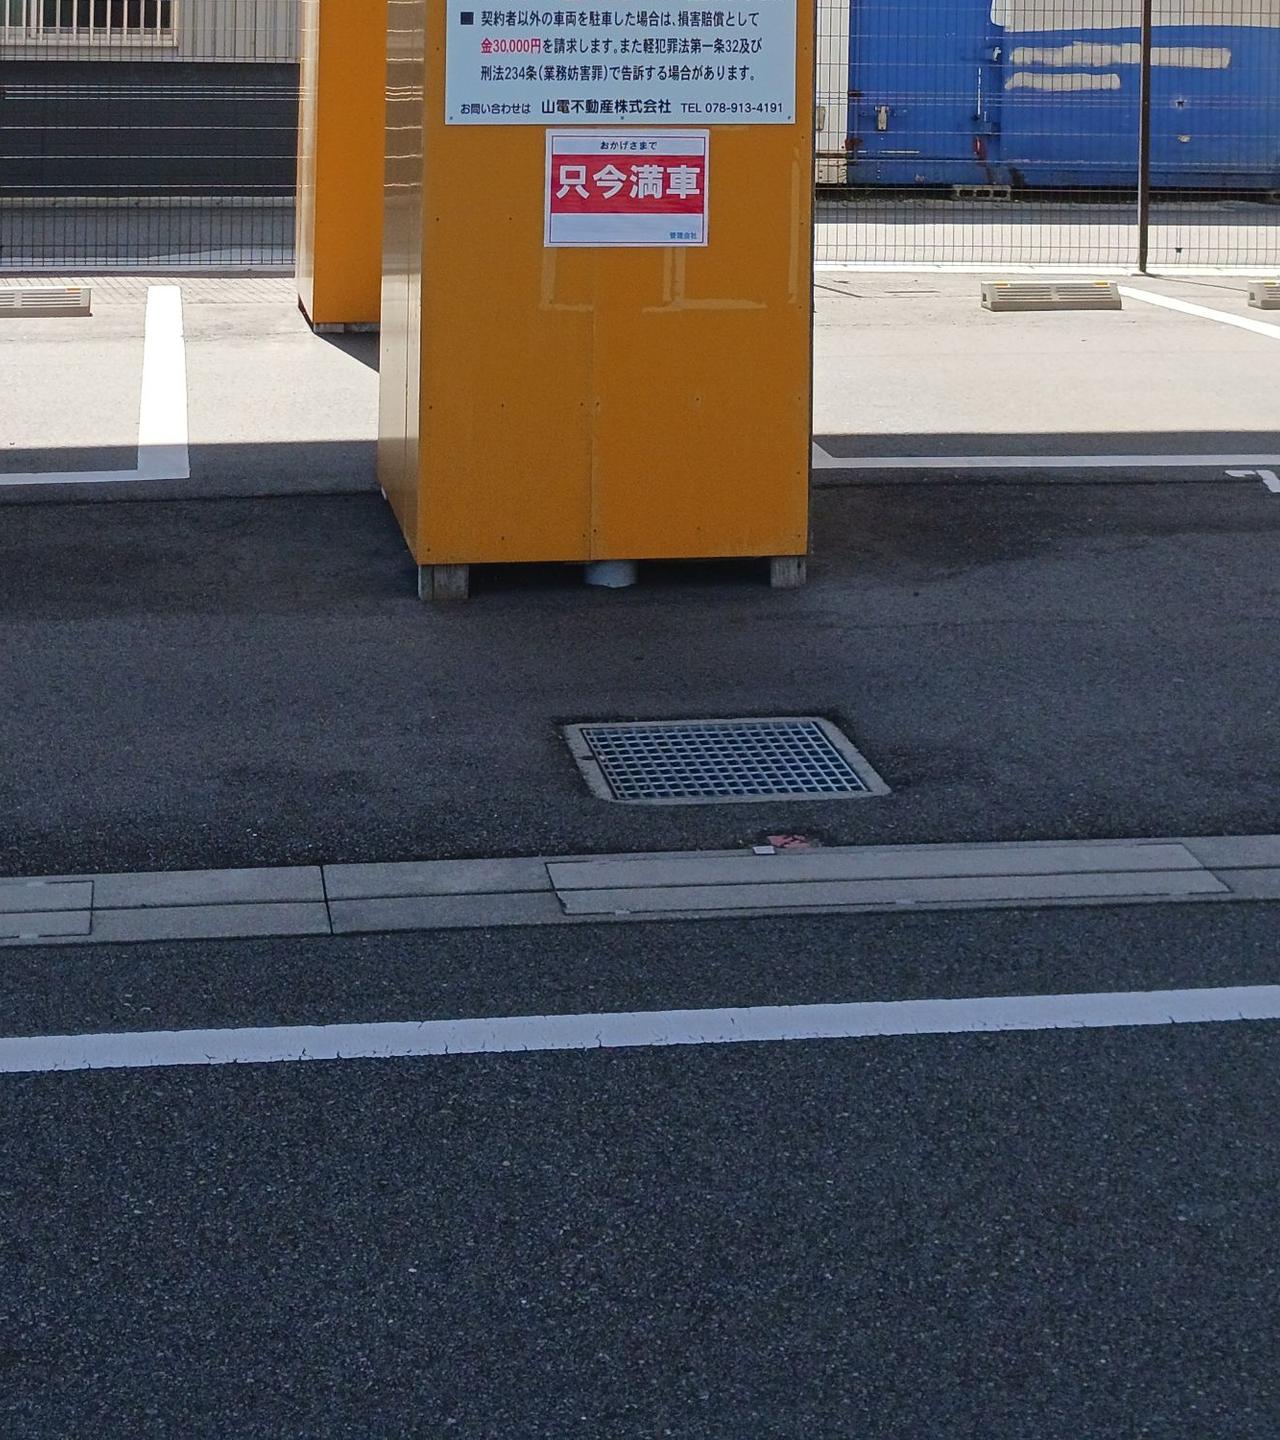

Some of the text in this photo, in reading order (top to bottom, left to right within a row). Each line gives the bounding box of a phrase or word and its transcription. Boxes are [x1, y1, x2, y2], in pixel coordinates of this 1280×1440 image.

[460, 98, 783, 115] お問い合わせは 山電不動産株式会社 TEL 078-913-4191
[600, 140, 658, 151] おかげさまで
[555, 164, 701, 200] 只今満車
